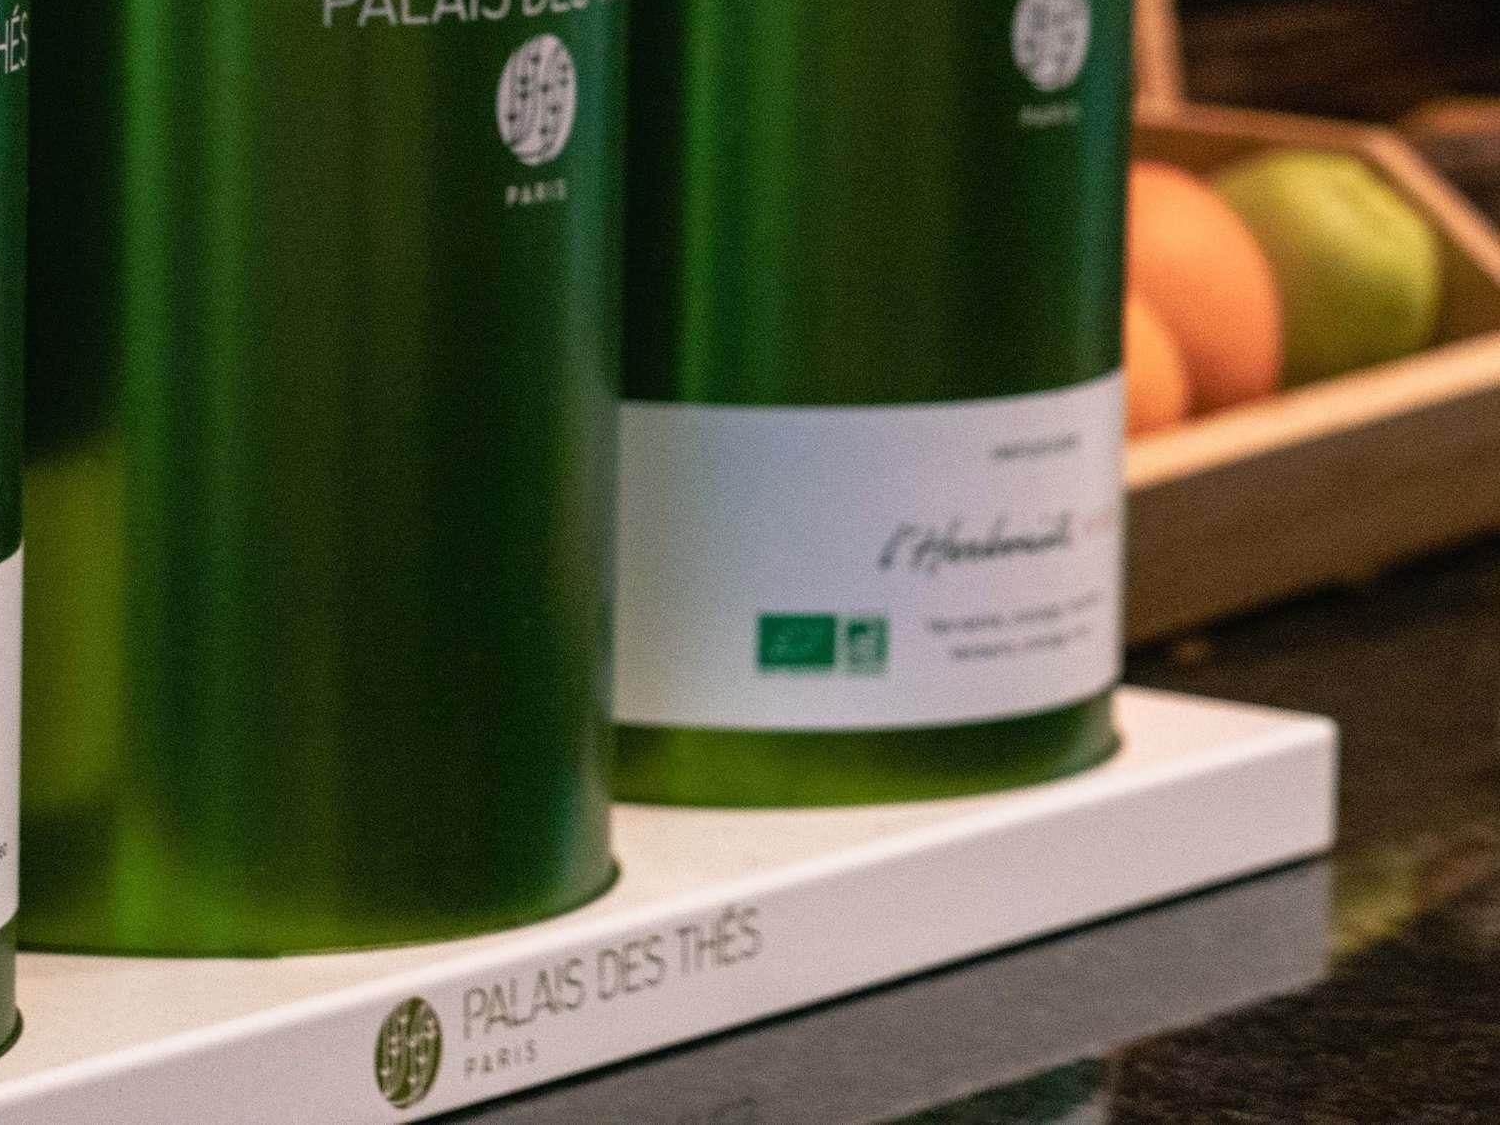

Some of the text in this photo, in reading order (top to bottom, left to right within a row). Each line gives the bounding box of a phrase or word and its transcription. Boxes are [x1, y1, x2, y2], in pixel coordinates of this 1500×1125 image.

[462, 904, 762, 1041] PALAIS DES THÉS
[464, 1039, 537, 1080] PARIS
